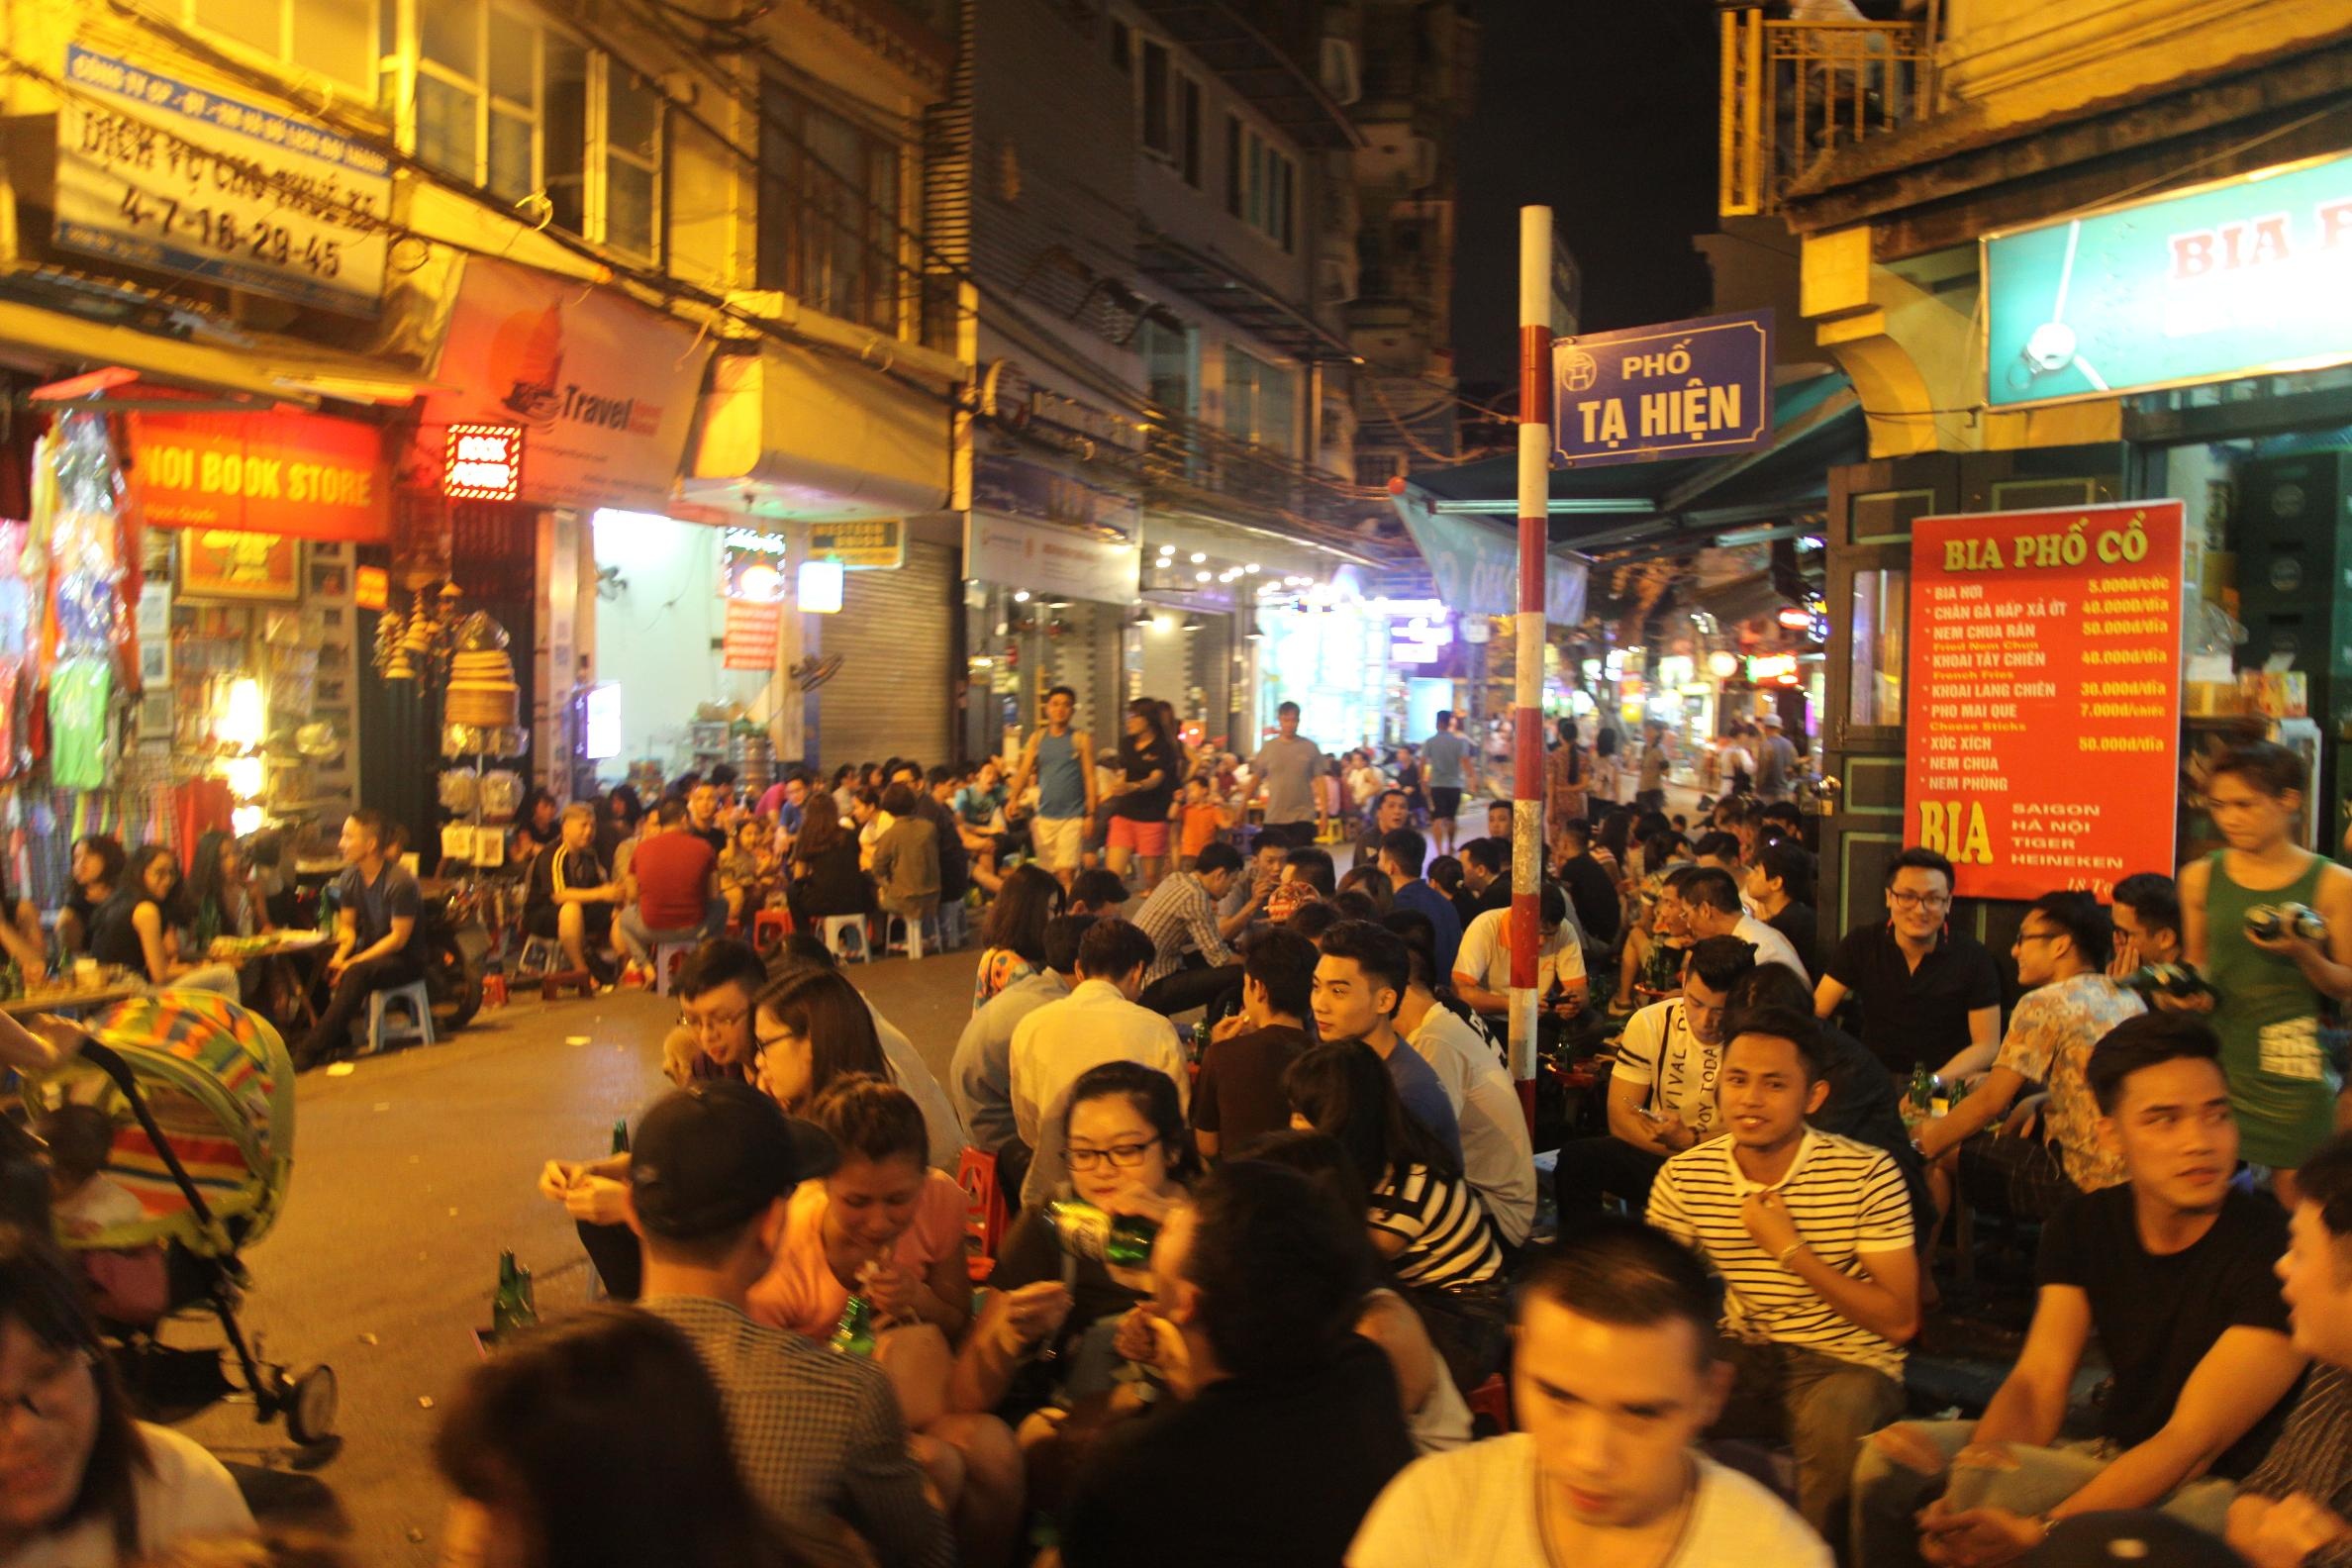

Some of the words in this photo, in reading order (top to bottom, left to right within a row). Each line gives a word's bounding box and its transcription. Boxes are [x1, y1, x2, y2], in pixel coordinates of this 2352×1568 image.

[2174, 218, 2290, 279] BIA
[1622, 339, 1692, 379] PHỐ
[560, 384, 635, 431] Travel
[1578, 398, 1628, 448] TẠ
[1640, 377, 1741, 441] HIỆN
[201, 450, 281, 500] BOOK
[288, 462, 372, 507] STORE
[1944, 538, 2005, 571] BIA
[2013, 517, 2088, 568] PHỐ
[1934, 587, 1957, 601] BIA
[1933, 626, 1964, 640] NEM
[1967, 625, 2004, 639] CHUA
[1933, 653, 1973, 668] KHOAI
[1932, 684, 1972, 698] KHOAI
[1975, 683, 2010, 698] LANG
[1931, 704, 1958, 718] PHO
[1961, 704, 1988, 718] MAI
[1991, 704, 2017, 719] QUE
[1929, 756, 1960, 771] NEM
[1963, 756, 1999, 771] CHUA
[1928, 776, 1959, 791] NEM
[1962, 773, 2009, 792] PHÙNG
[2011, 803, 2101, 817] SAIGON
[1919, 801, 1994, 864] BIA
[2050, 819, 2091, 835] NỘI
[2010, 836, 2076, 850] TIGER
[2010, 853, 2123, 869] HEINEKEN
